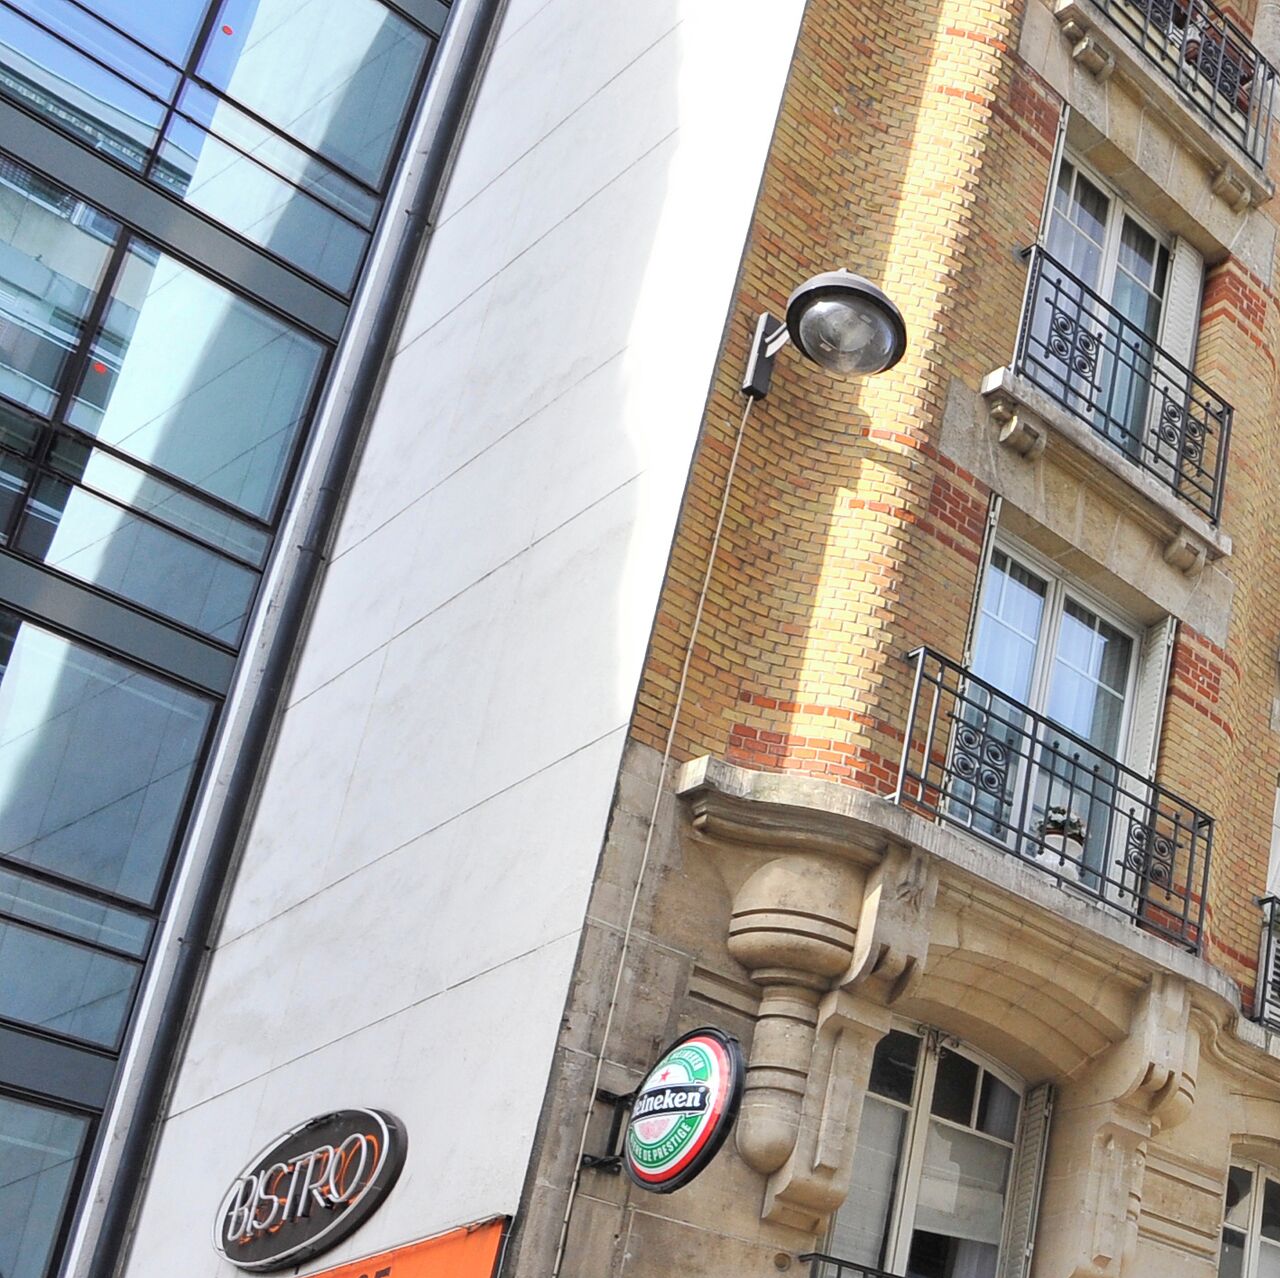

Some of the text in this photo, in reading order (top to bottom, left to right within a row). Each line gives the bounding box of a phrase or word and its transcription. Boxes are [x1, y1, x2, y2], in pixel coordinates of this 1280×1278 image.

[634, 1088, 704, 1116] eineken
[652, 1122, 692, 1161] PRESTIGE
[227, 1133, 374, 1243] BISTRO
